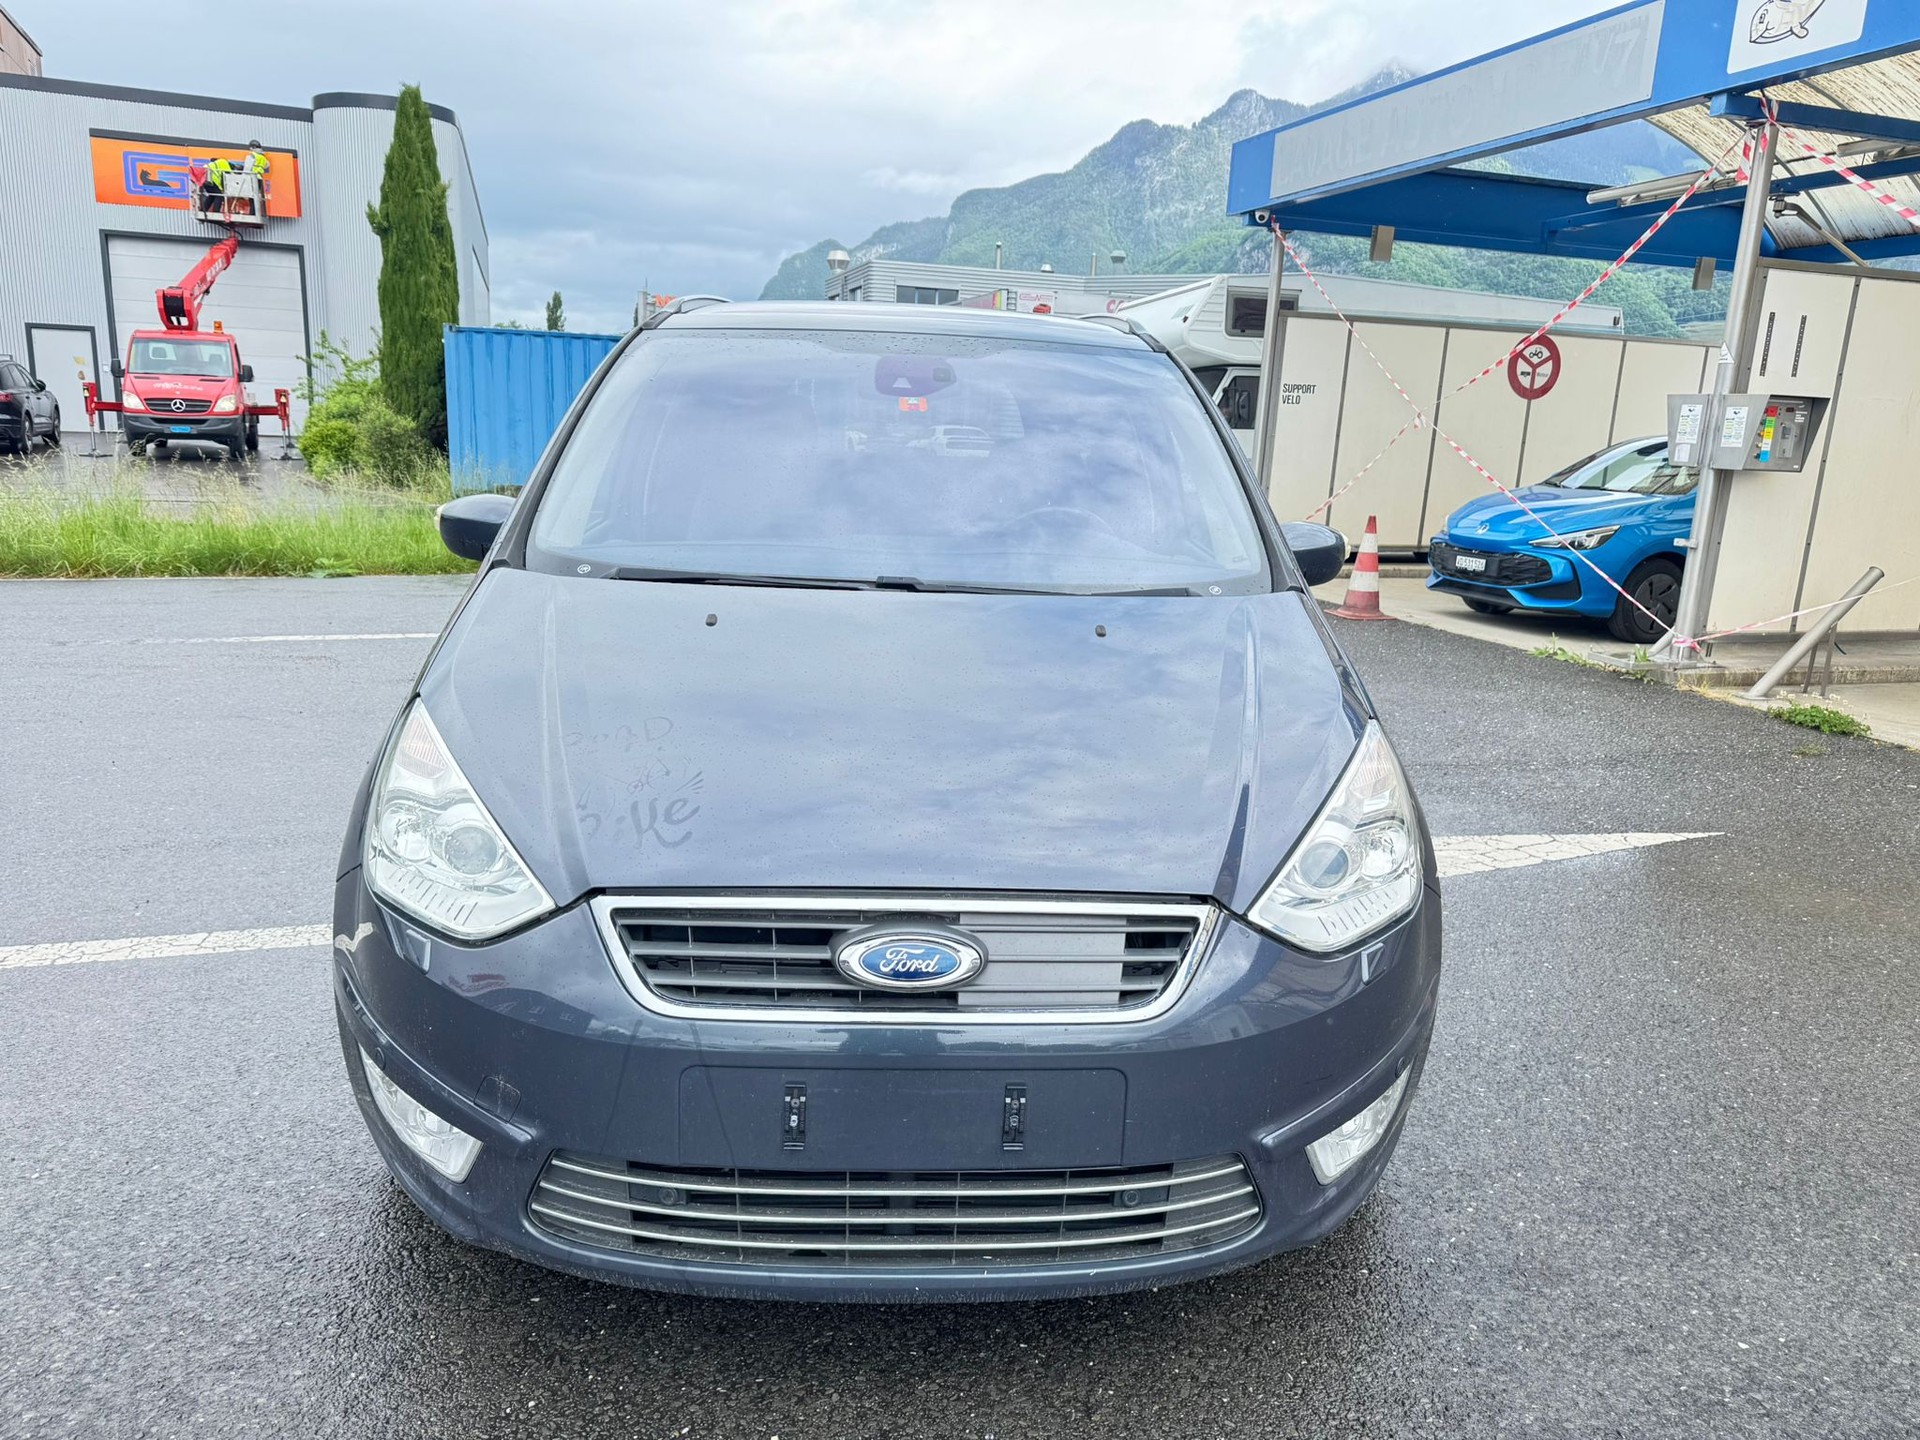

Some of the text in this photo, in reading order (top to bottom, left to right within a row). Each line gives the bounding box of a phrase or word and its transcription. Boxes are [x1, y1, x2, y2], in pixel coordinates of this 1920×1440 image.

[1282, 383, 1317, 394] SUPPORT
[1281, 394, 1301, 405] VELO
[879, 946, 940, 973] Ford
